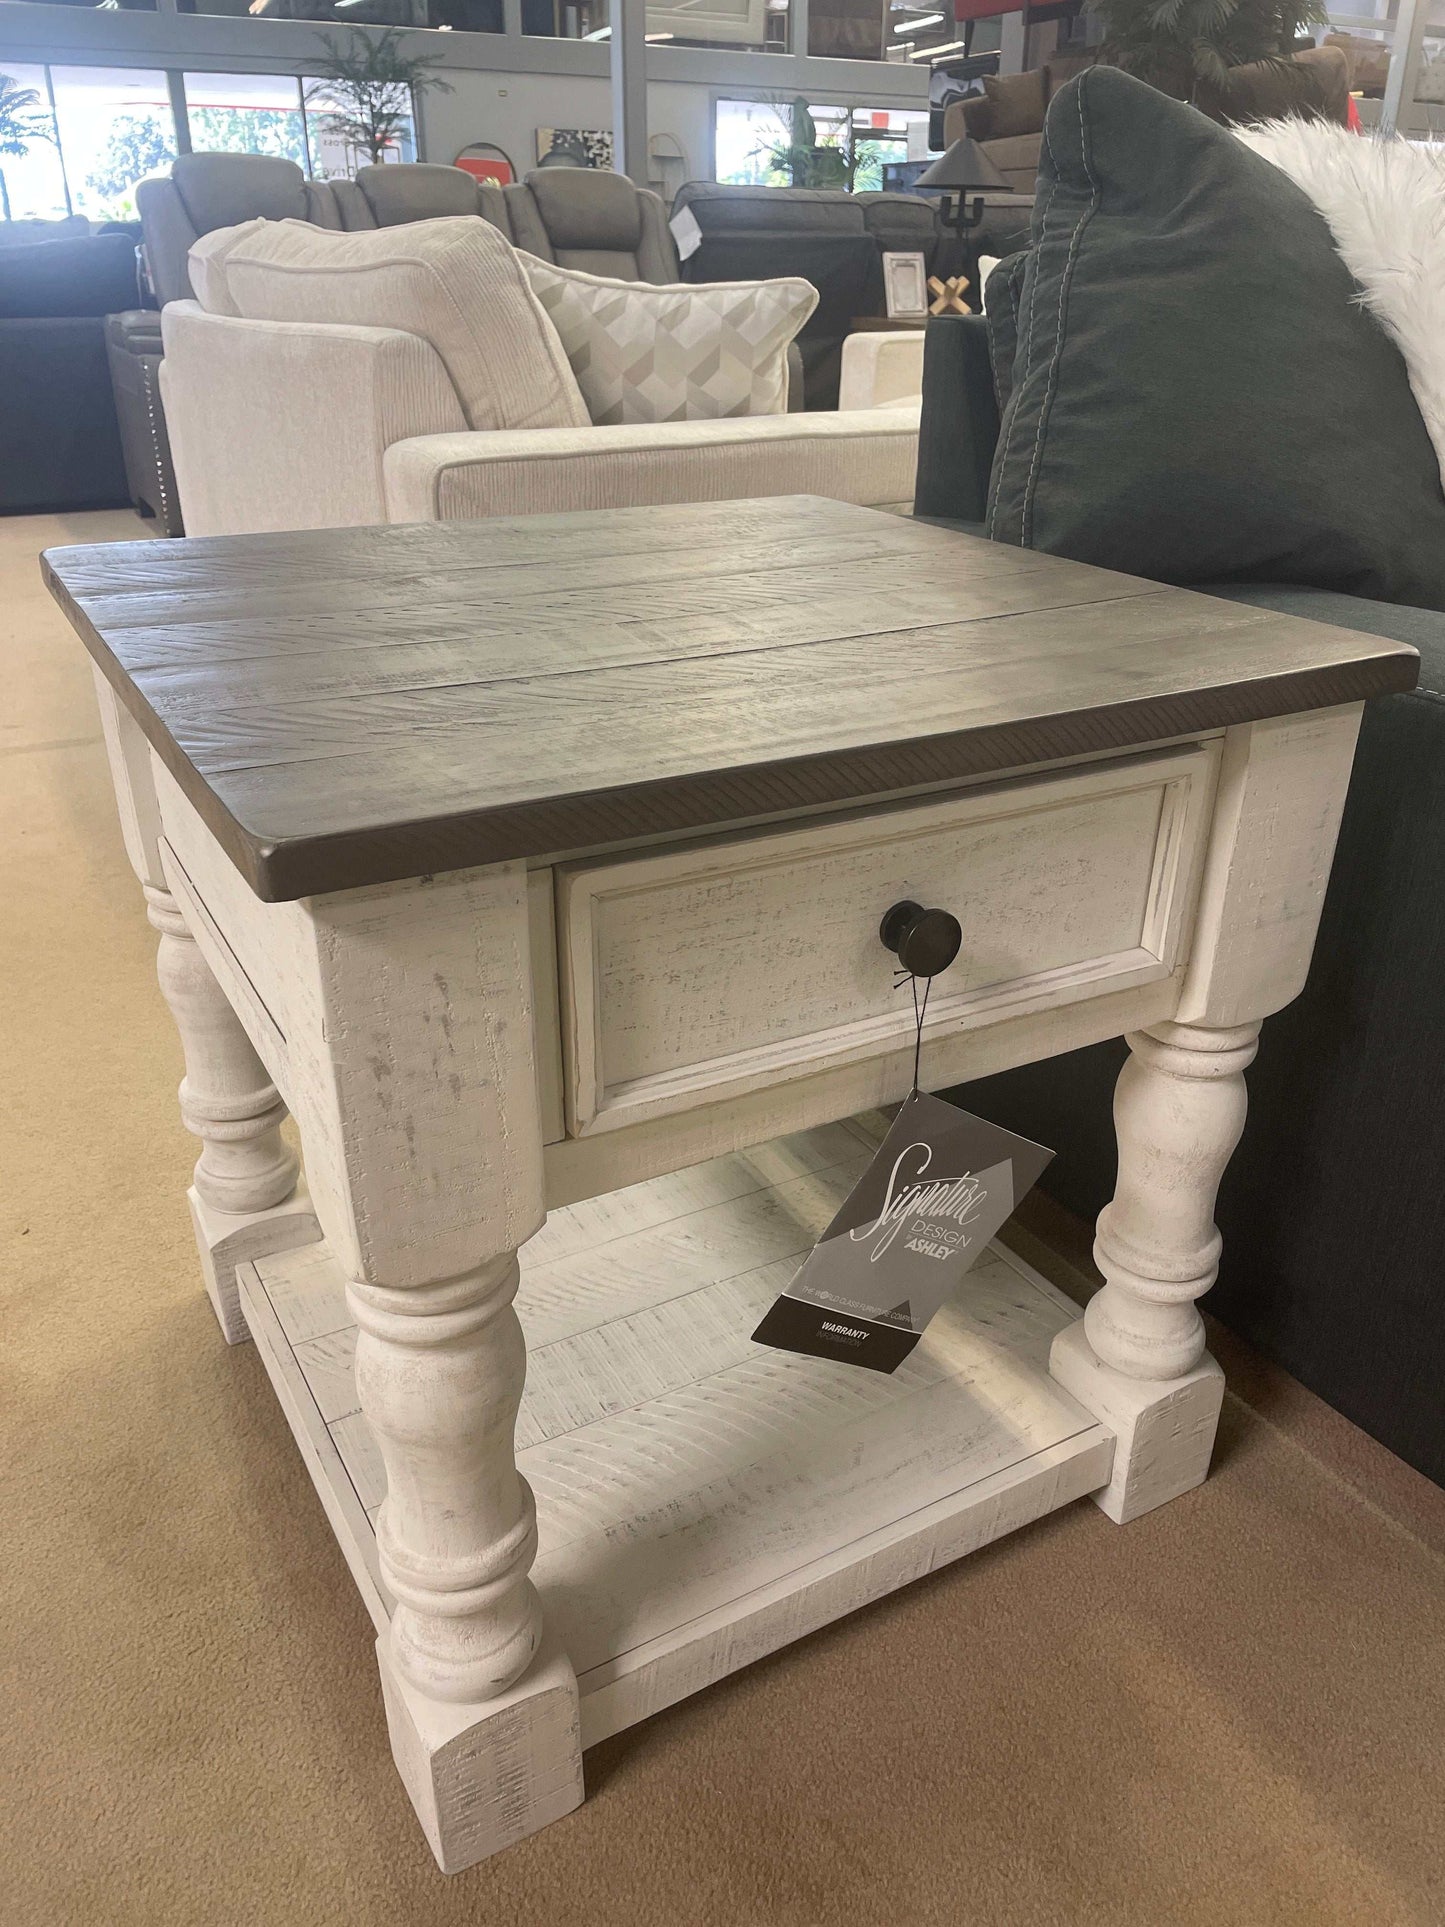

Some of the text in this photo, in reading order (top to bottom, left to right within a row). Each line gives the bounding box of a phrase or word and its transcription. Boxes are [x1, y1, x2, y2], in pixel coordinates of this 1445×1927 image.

[849, 1142, 988, 1263] Signature
[911, 1219, 972, 1248] DESIGN
[903, 1237, 956, 1260] ASHLEY
[821, 1321, 870, 1340] WARRANTY
